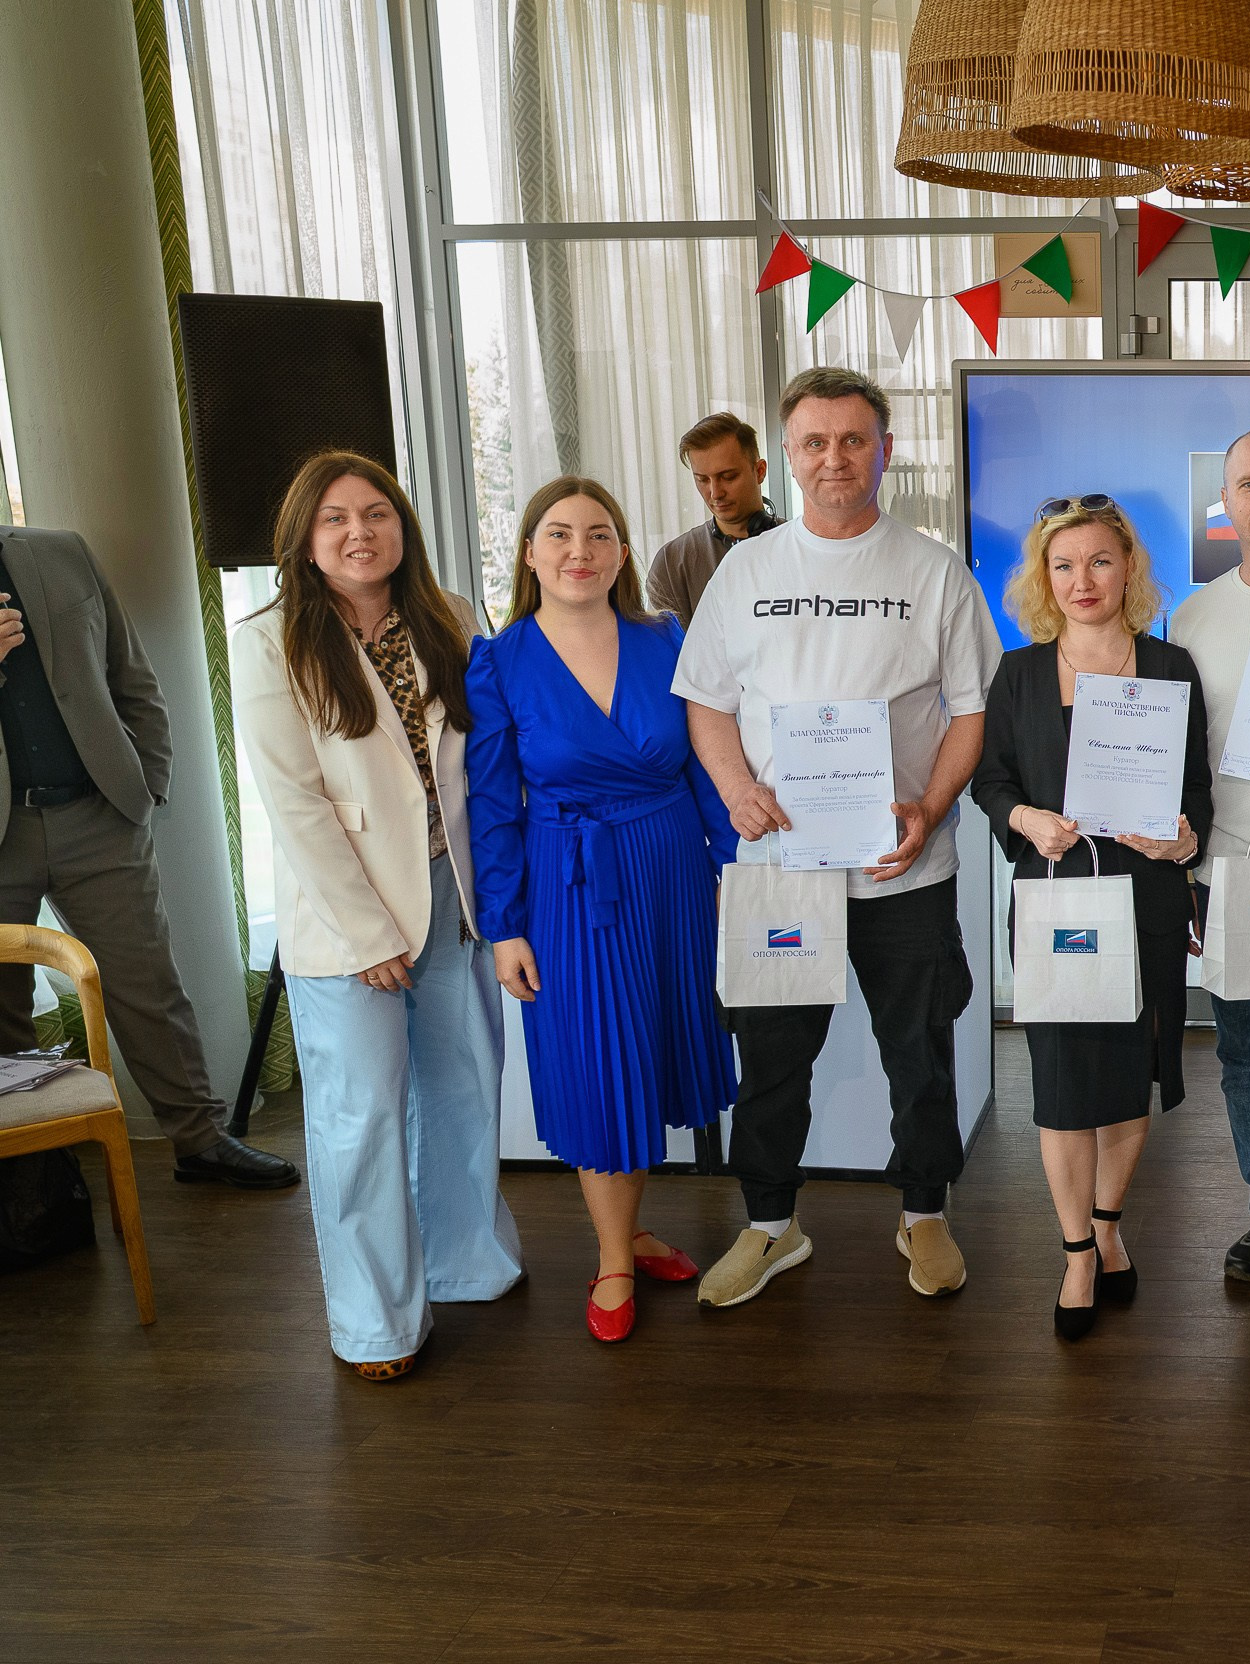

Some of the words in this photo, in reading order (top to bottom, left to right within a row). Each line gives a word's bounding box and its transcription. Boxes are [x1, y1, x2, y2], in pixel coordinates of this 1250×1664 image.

[754, 595, 911, 619] carhartt
[1092, 699, 1170, 713] БЛАГОДАРСТВЕННОЕ
[1114, 709, 1147, 718] ПИСЬМО
[789, 727, 872, 738] БЛАГОДАРСТВЕННОЕ
[814, 736, 849, 744] ПИСЬМО
[1087, 739, 1131, 751] Светлана
[1135, 744, 1169, 755] Шведич
[1113, 756, 1140, 765] Куратор
[781, 773, 826, 782] Виталий
